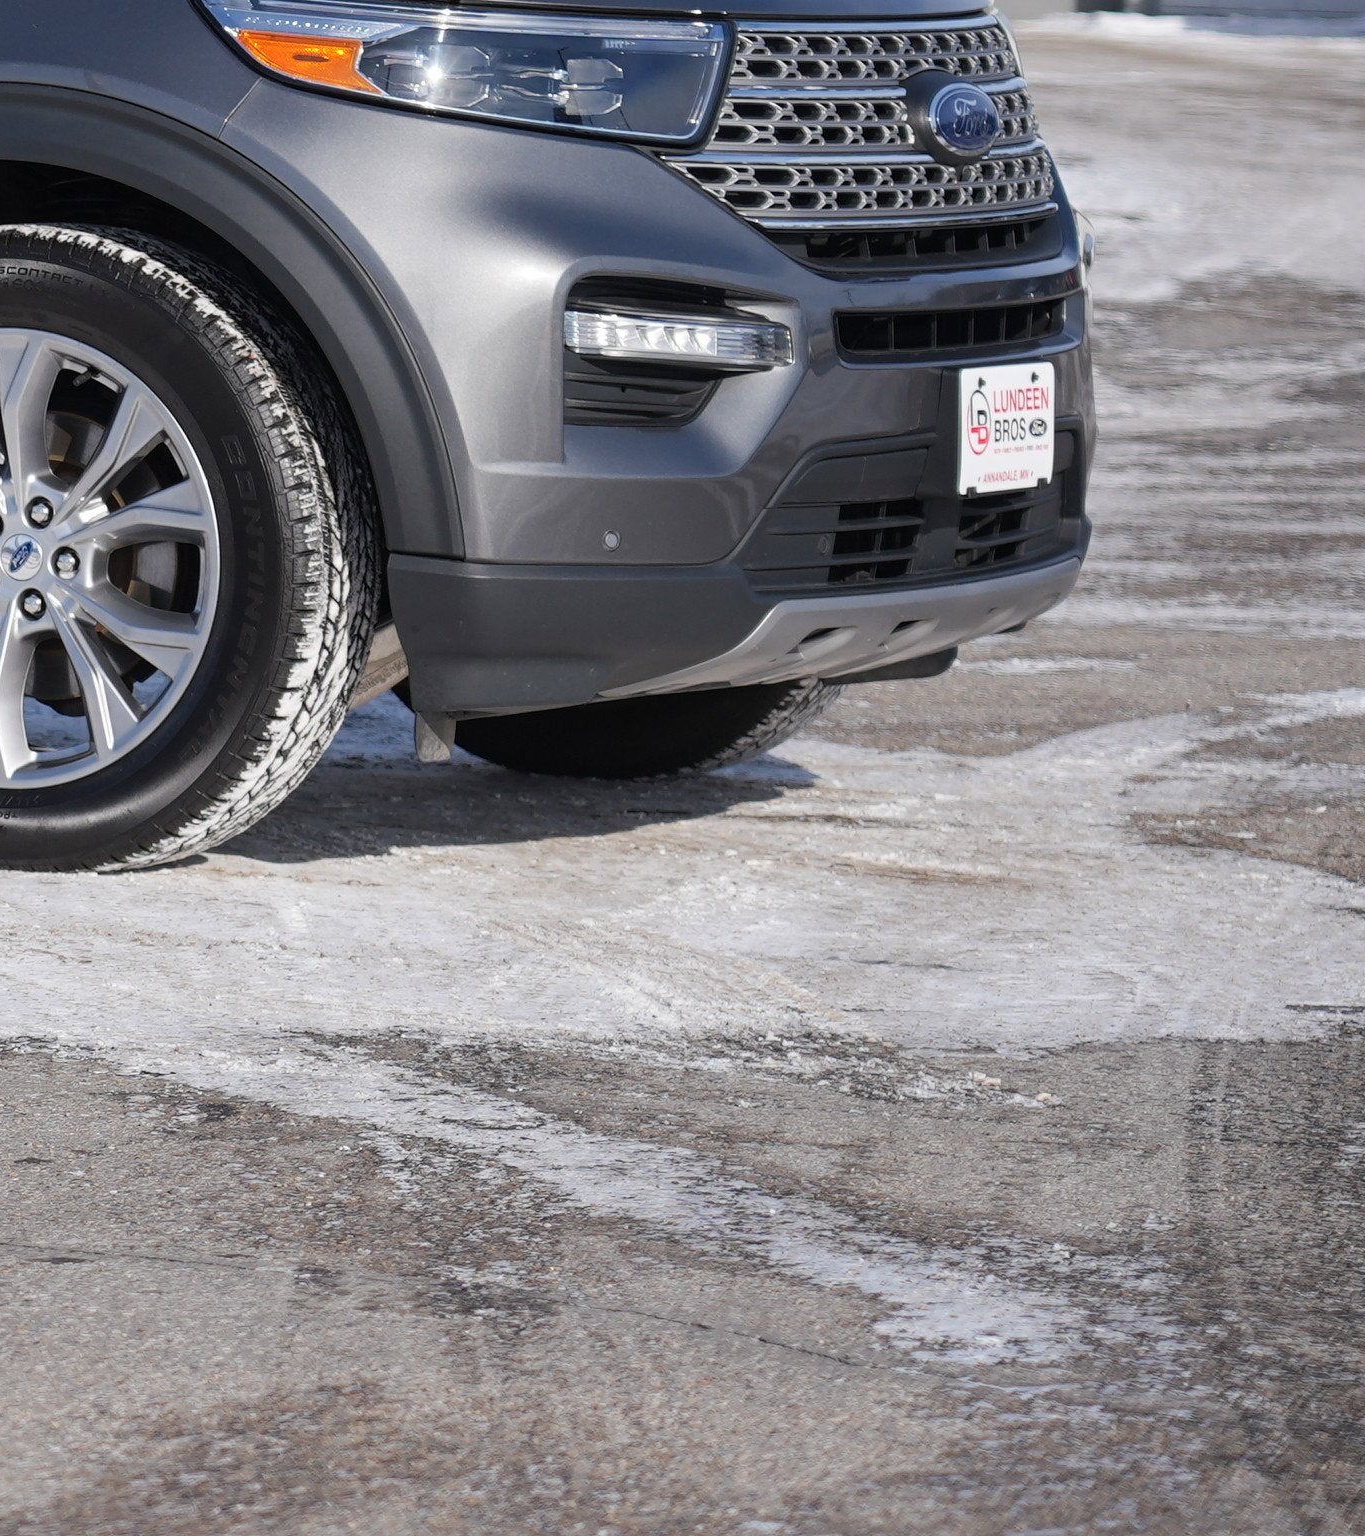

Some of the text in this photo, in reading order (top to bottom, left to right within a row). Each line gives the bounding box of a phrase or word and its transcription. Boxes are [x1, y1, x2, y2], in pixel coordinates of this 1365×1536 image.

[954, 98, 990, 137] Ford
[994, 387, 1049, 412] LUNDEEN
[995, 418, 1026, 441] BROS
